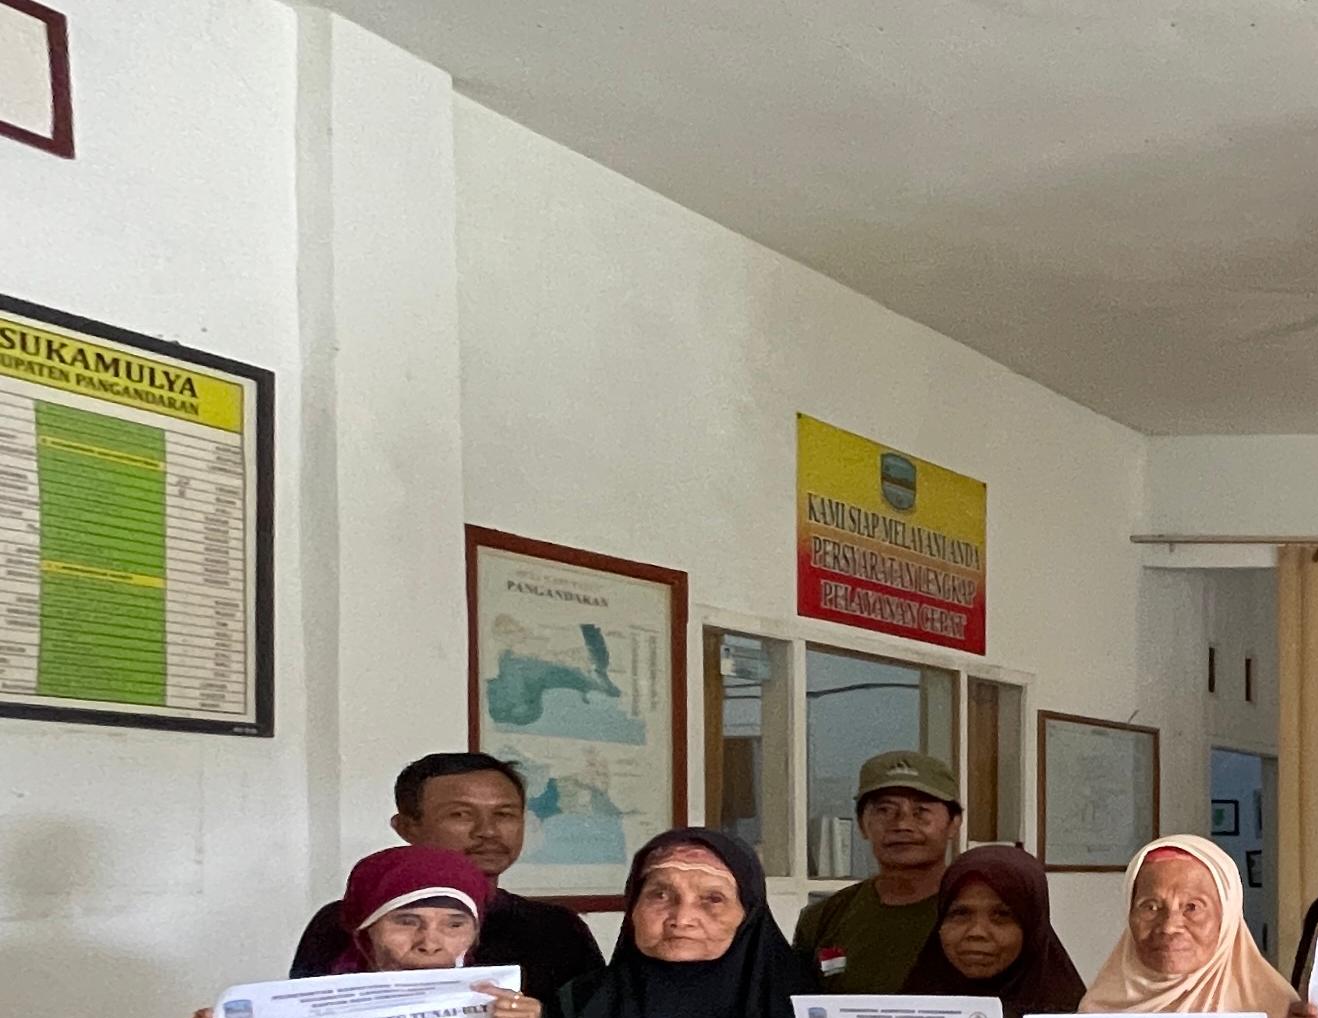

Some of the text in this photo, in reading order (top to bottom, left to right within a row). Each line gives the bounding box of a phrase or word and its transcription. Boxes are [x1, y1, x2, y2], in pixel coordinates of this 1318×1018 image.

[0, 327, 198, 398] SUKAMULYA
[76, 373, 199, 415] PANGANDARAN
[808, 492, 845, 530] KAMI
